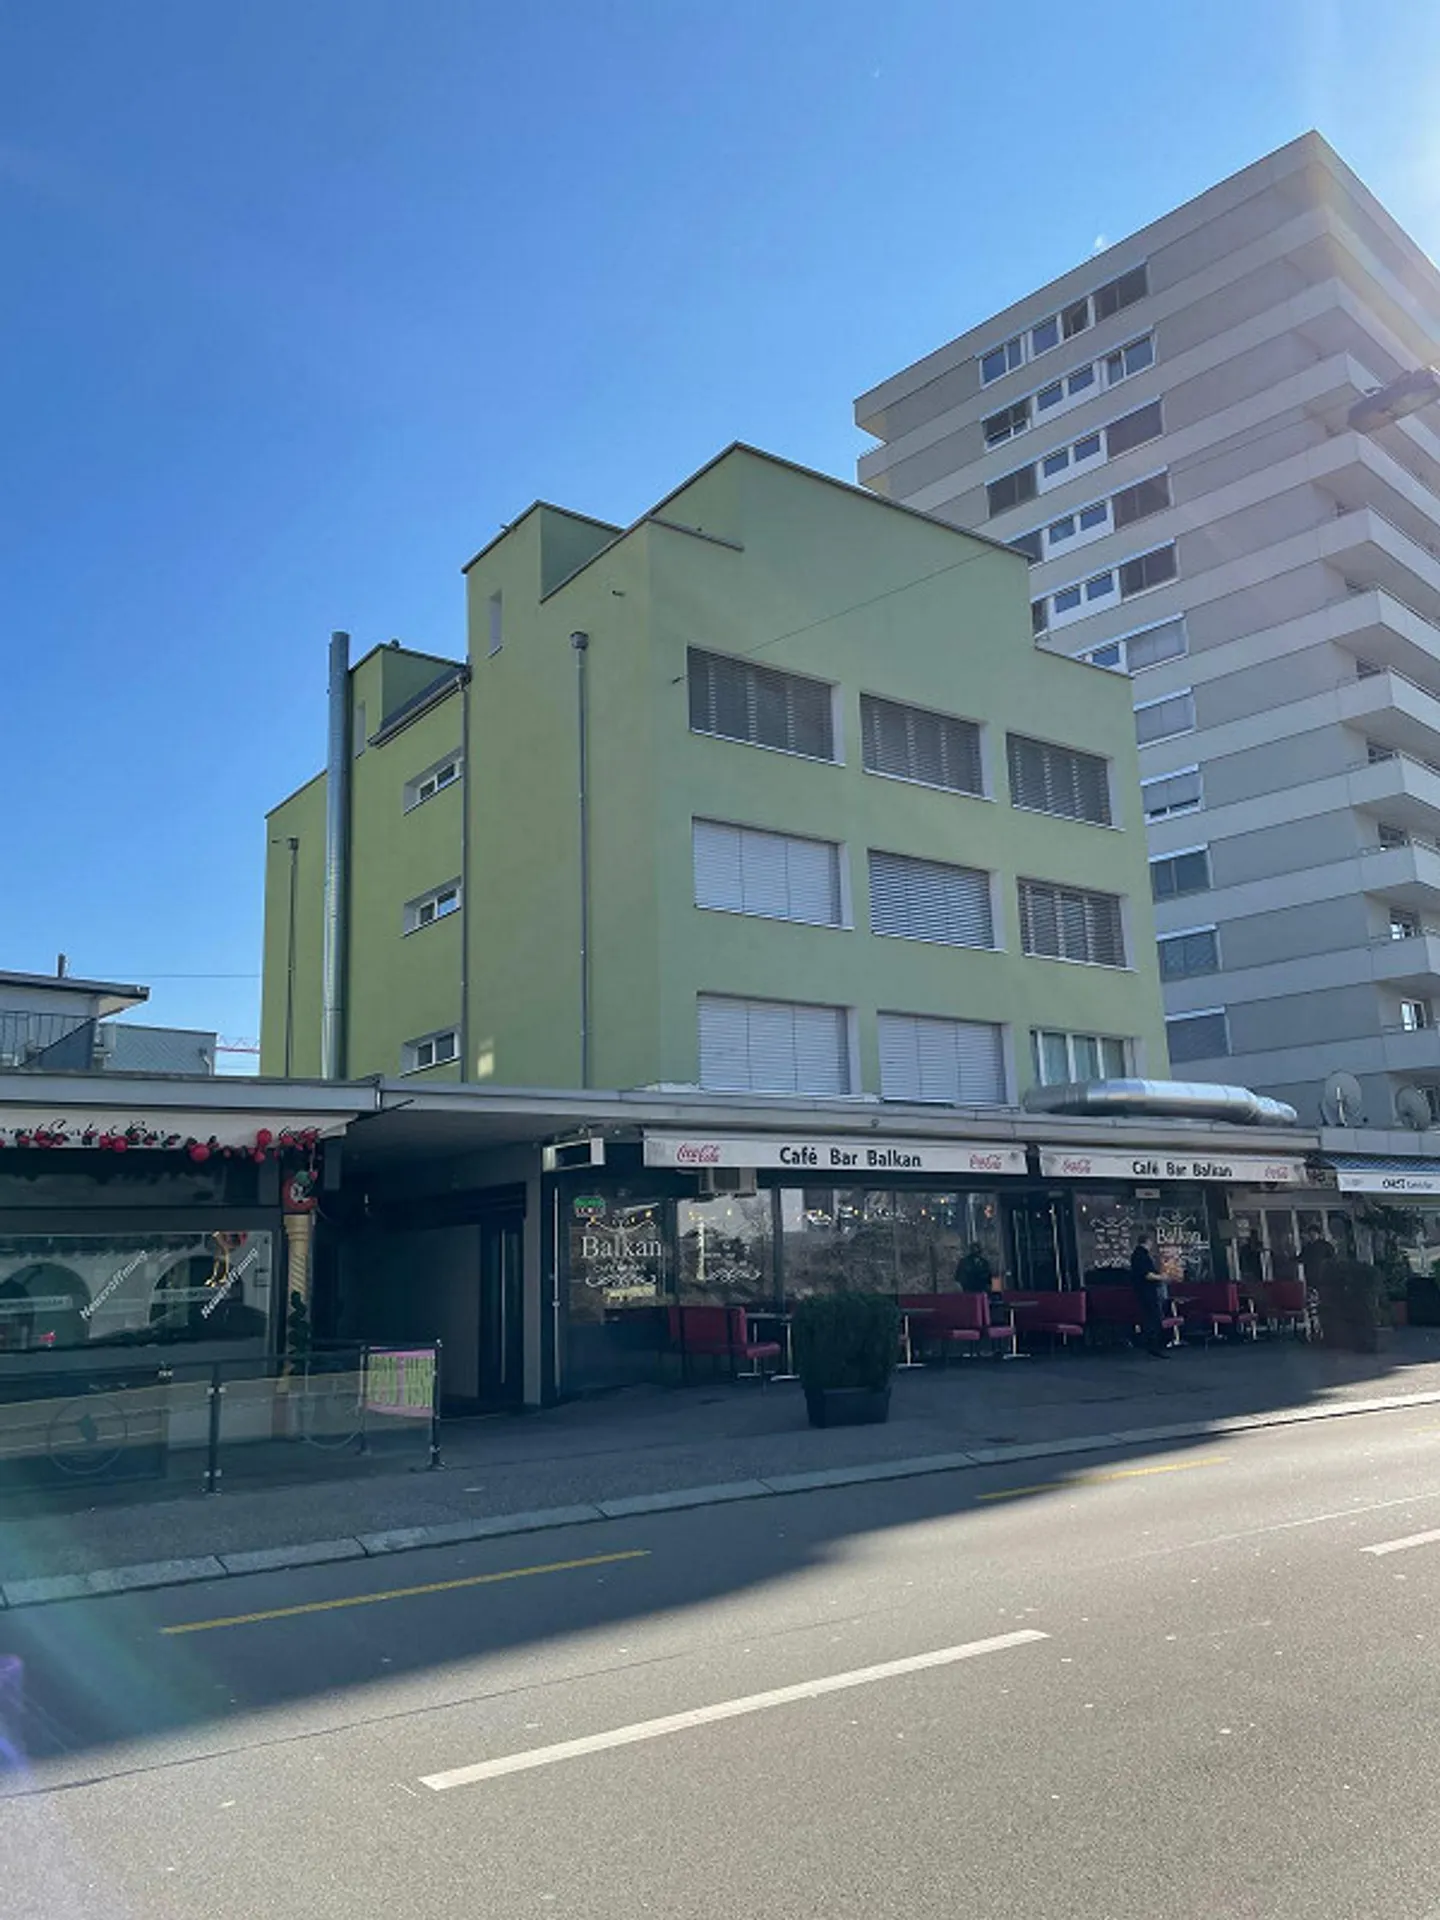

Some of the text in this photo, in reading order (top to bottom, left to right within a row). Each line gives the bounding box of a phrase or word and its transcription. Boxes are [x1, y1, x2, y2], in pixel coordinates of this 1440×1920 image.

[779, 1147, 922, 1168] Café Bar Balkan
[1166, 1161, 1187, 1177] Bar
[1193, 1161, 1232, 1178] Balkan
[1156, 1227, 1201, 1245] Balkan
[581, 1236, 661, 1258] Balkan
